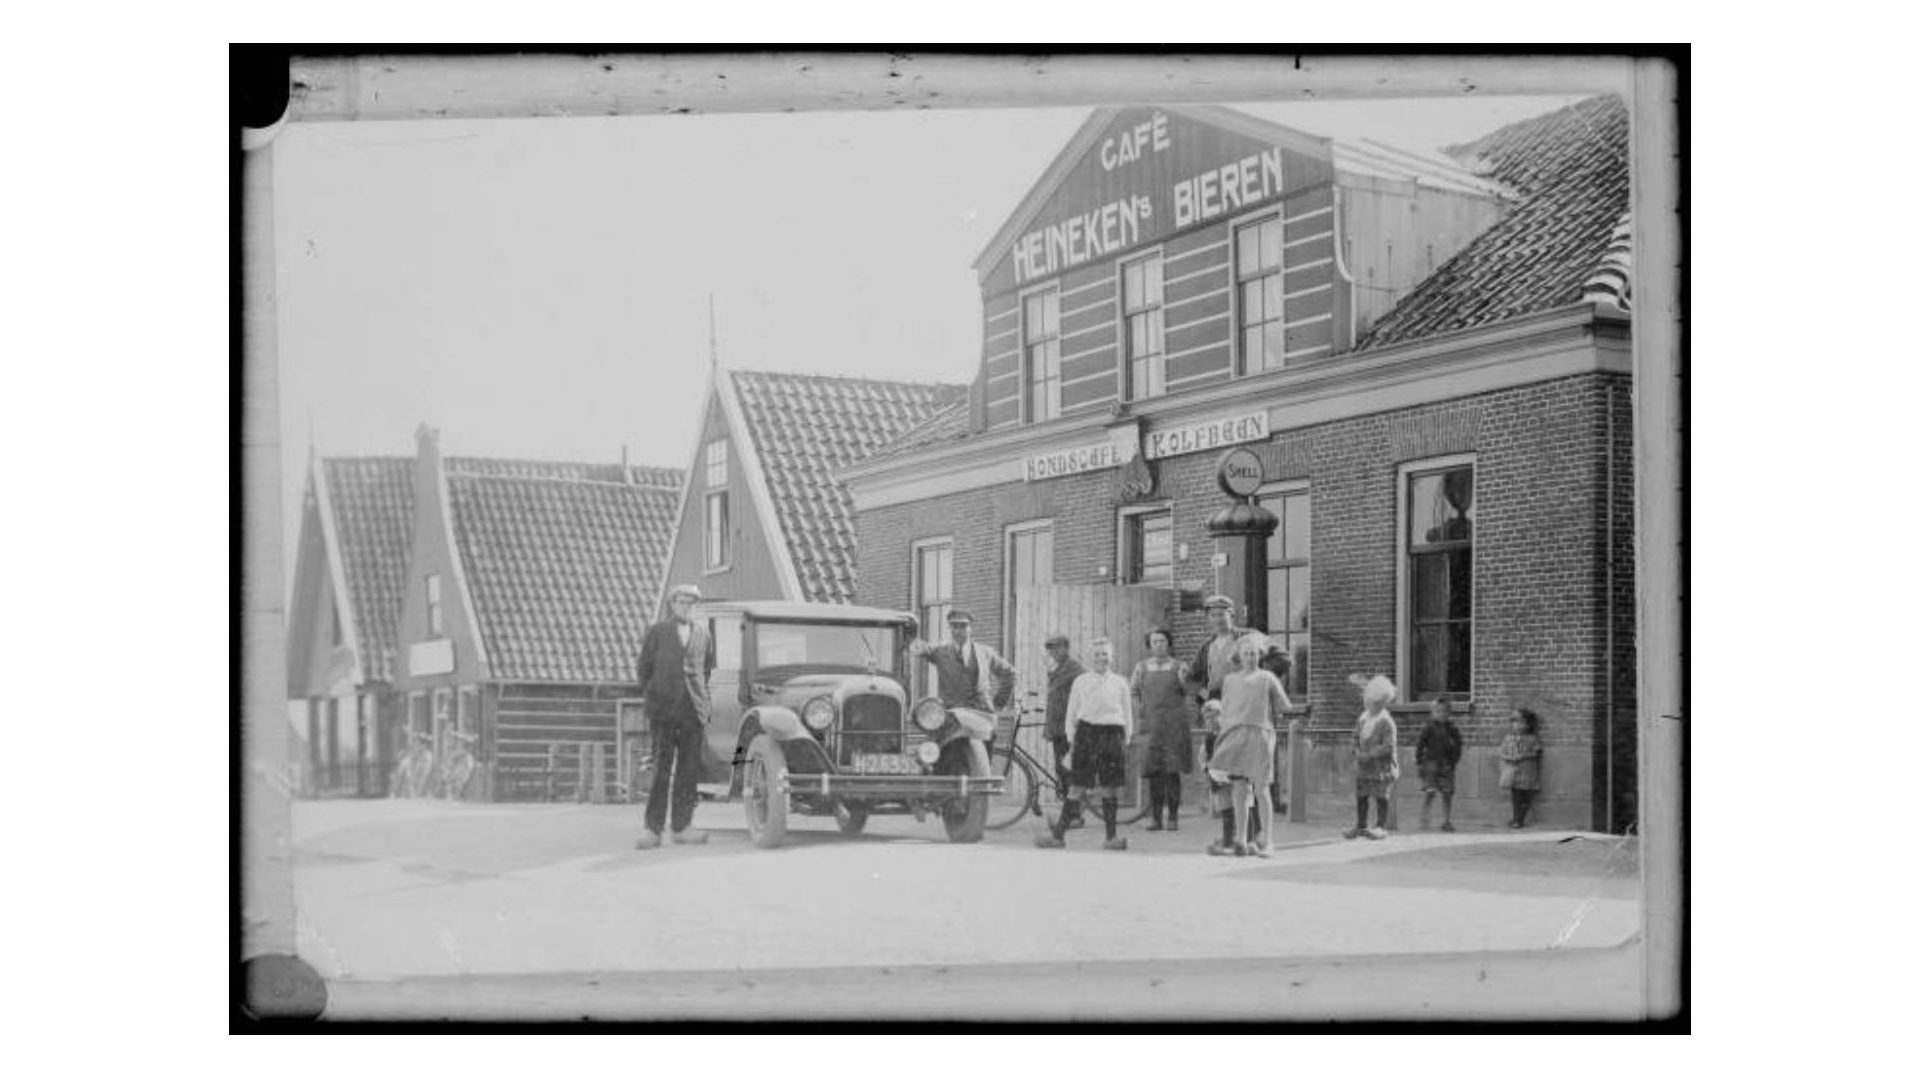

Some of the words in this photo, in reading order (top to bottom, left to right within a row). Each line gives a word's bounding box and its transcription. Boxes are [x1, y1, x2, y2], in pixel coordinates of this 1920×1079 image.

[1101, 110, 1171, 171] CAFÉ
[1174, 147, 1284, 229] BIEREN
[1228, 462, 1260, 480] SHELL
